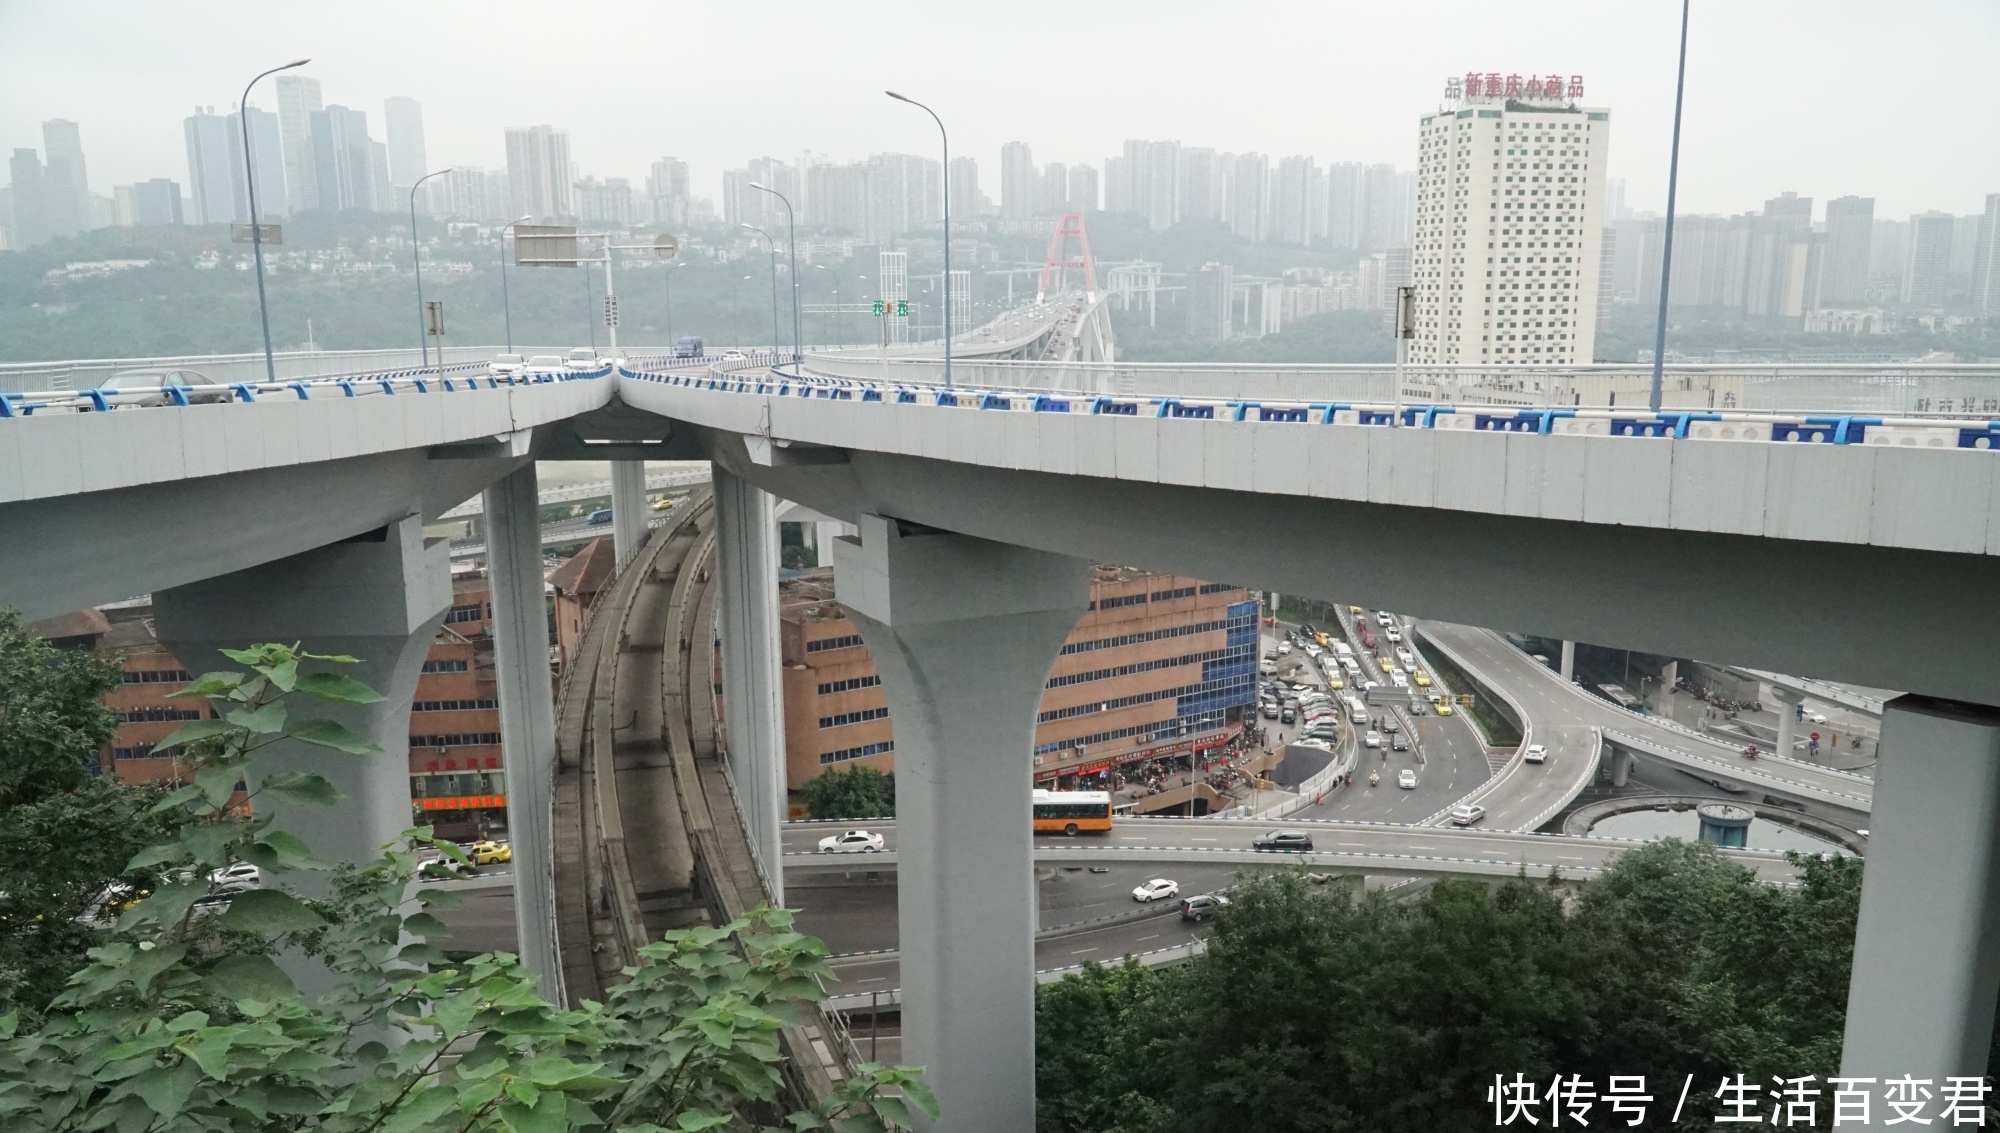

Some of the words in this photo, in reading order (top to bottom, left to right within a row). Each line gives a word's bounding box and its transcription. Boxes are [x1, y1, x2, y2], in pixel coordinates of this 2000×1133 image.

[1464, 72, 1584, 98] 新重庆小商品
